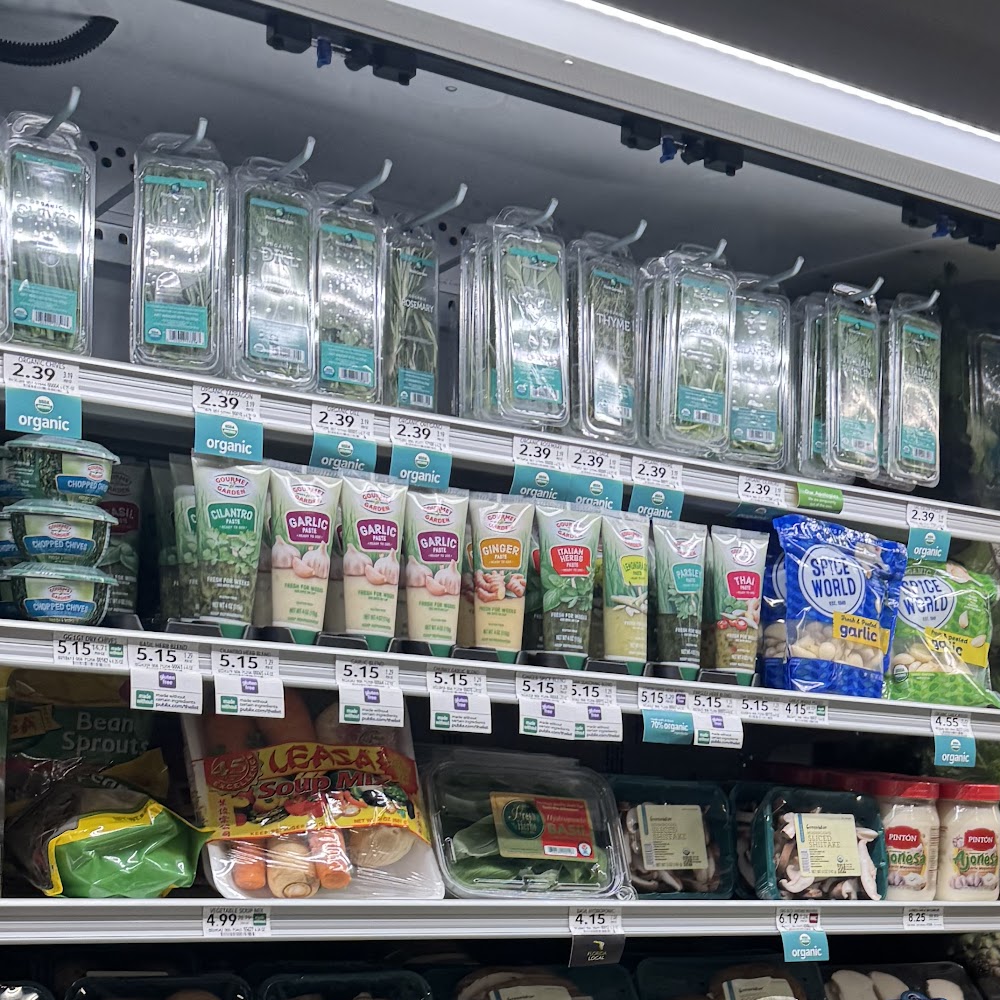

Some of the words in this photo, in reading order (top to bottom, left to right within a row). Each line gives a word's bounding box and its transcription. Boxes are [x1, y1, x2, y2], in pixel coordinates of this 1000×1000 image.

[596, 313, 631, 332] THYME
[12, 362, 56, 381] 2.39
[199, 393, 239, 410] 2.39
[18, 413, 70, 432] organic
[318, 411, 355, 428] 2.39
[396, 424, 431, 440] 2.39
[206, 438, 252, 455] organic
[519, 443, 551, 460] 2.39
[321, 454, 365, 471] organic
[573, 452, 604, 468] 2.39
[399, 469, 441, 486] organic
[637, 463, 667, 479] 2.39
[67, 480, 98, 489] CHOPPED
[215, 476, 250, 487] GOURMET
[217, 487, 246, 497] GARDEN
[519, 487, 558, 500] organic
[744, 482, 770, 496] 2.39
[575, 495, 614, 510] organic
[210, 508, 253, 521] CILANTRO
[637, 504, 673, 520] organic
[911, 509, 935, 522] 2.39
[289, 516, 328, 530] GARLIC
[359, 525, 397, 538] GARLIC
[32, 539, 64, 550] CHOPPED
[65, 540, 88, 551] CHIVES
[420, 537, 457, 549] GARLIC
[483, 544, 520, 556] GINGER
[558, 548, 584, 556] ITALIAN
[913, 545, 942, 558] organic
[812, 556, 850, 577] SPICE
[734, 576, 755, 586] THAI
[811, 577, 856, 598] WORLD
[901, 578, 942, 593] SPICE
[33, 602, 64, 612] CHOPPED
[65, 604, 88, 614] CHIVES
[903, 596, 948, 616] WORLD
[840, 623, 877, 642] garlic
[57, 640, 91, 656] 5.15
[136, 648, 177, 663] 5.15
[219, 654, 258, 669] 5.15
[160, 674, 175, 682] gluten
[343, 664, 379, 679] 5.15
[434, 672, 468, 686] 5.15
[522, 680, 554, 694] 5.15
[571, 684, 600, 698] 5.15
[694, 695, 722, 708] 5.15
[741, 700, 769, 712] 5.15
[77, 712, 134, 732] Bean
[650, 721, 664, 730] 70%
[664, 721, 689, 731] organic
[935, 716, 959, 727] 4.55
[61, 731, 150, 761] Sprouts
[941, 753, 970, 764] organic
[888, 833, 917, 843] PINTÓN
[206, 914, 237, 927] 4.99
[575, 914, 606, 925] 4.15
[779, 913, 799, 924] 6.19
[908, 913, 926, 922] 8.25
[791, 946, 822, 958] organic
